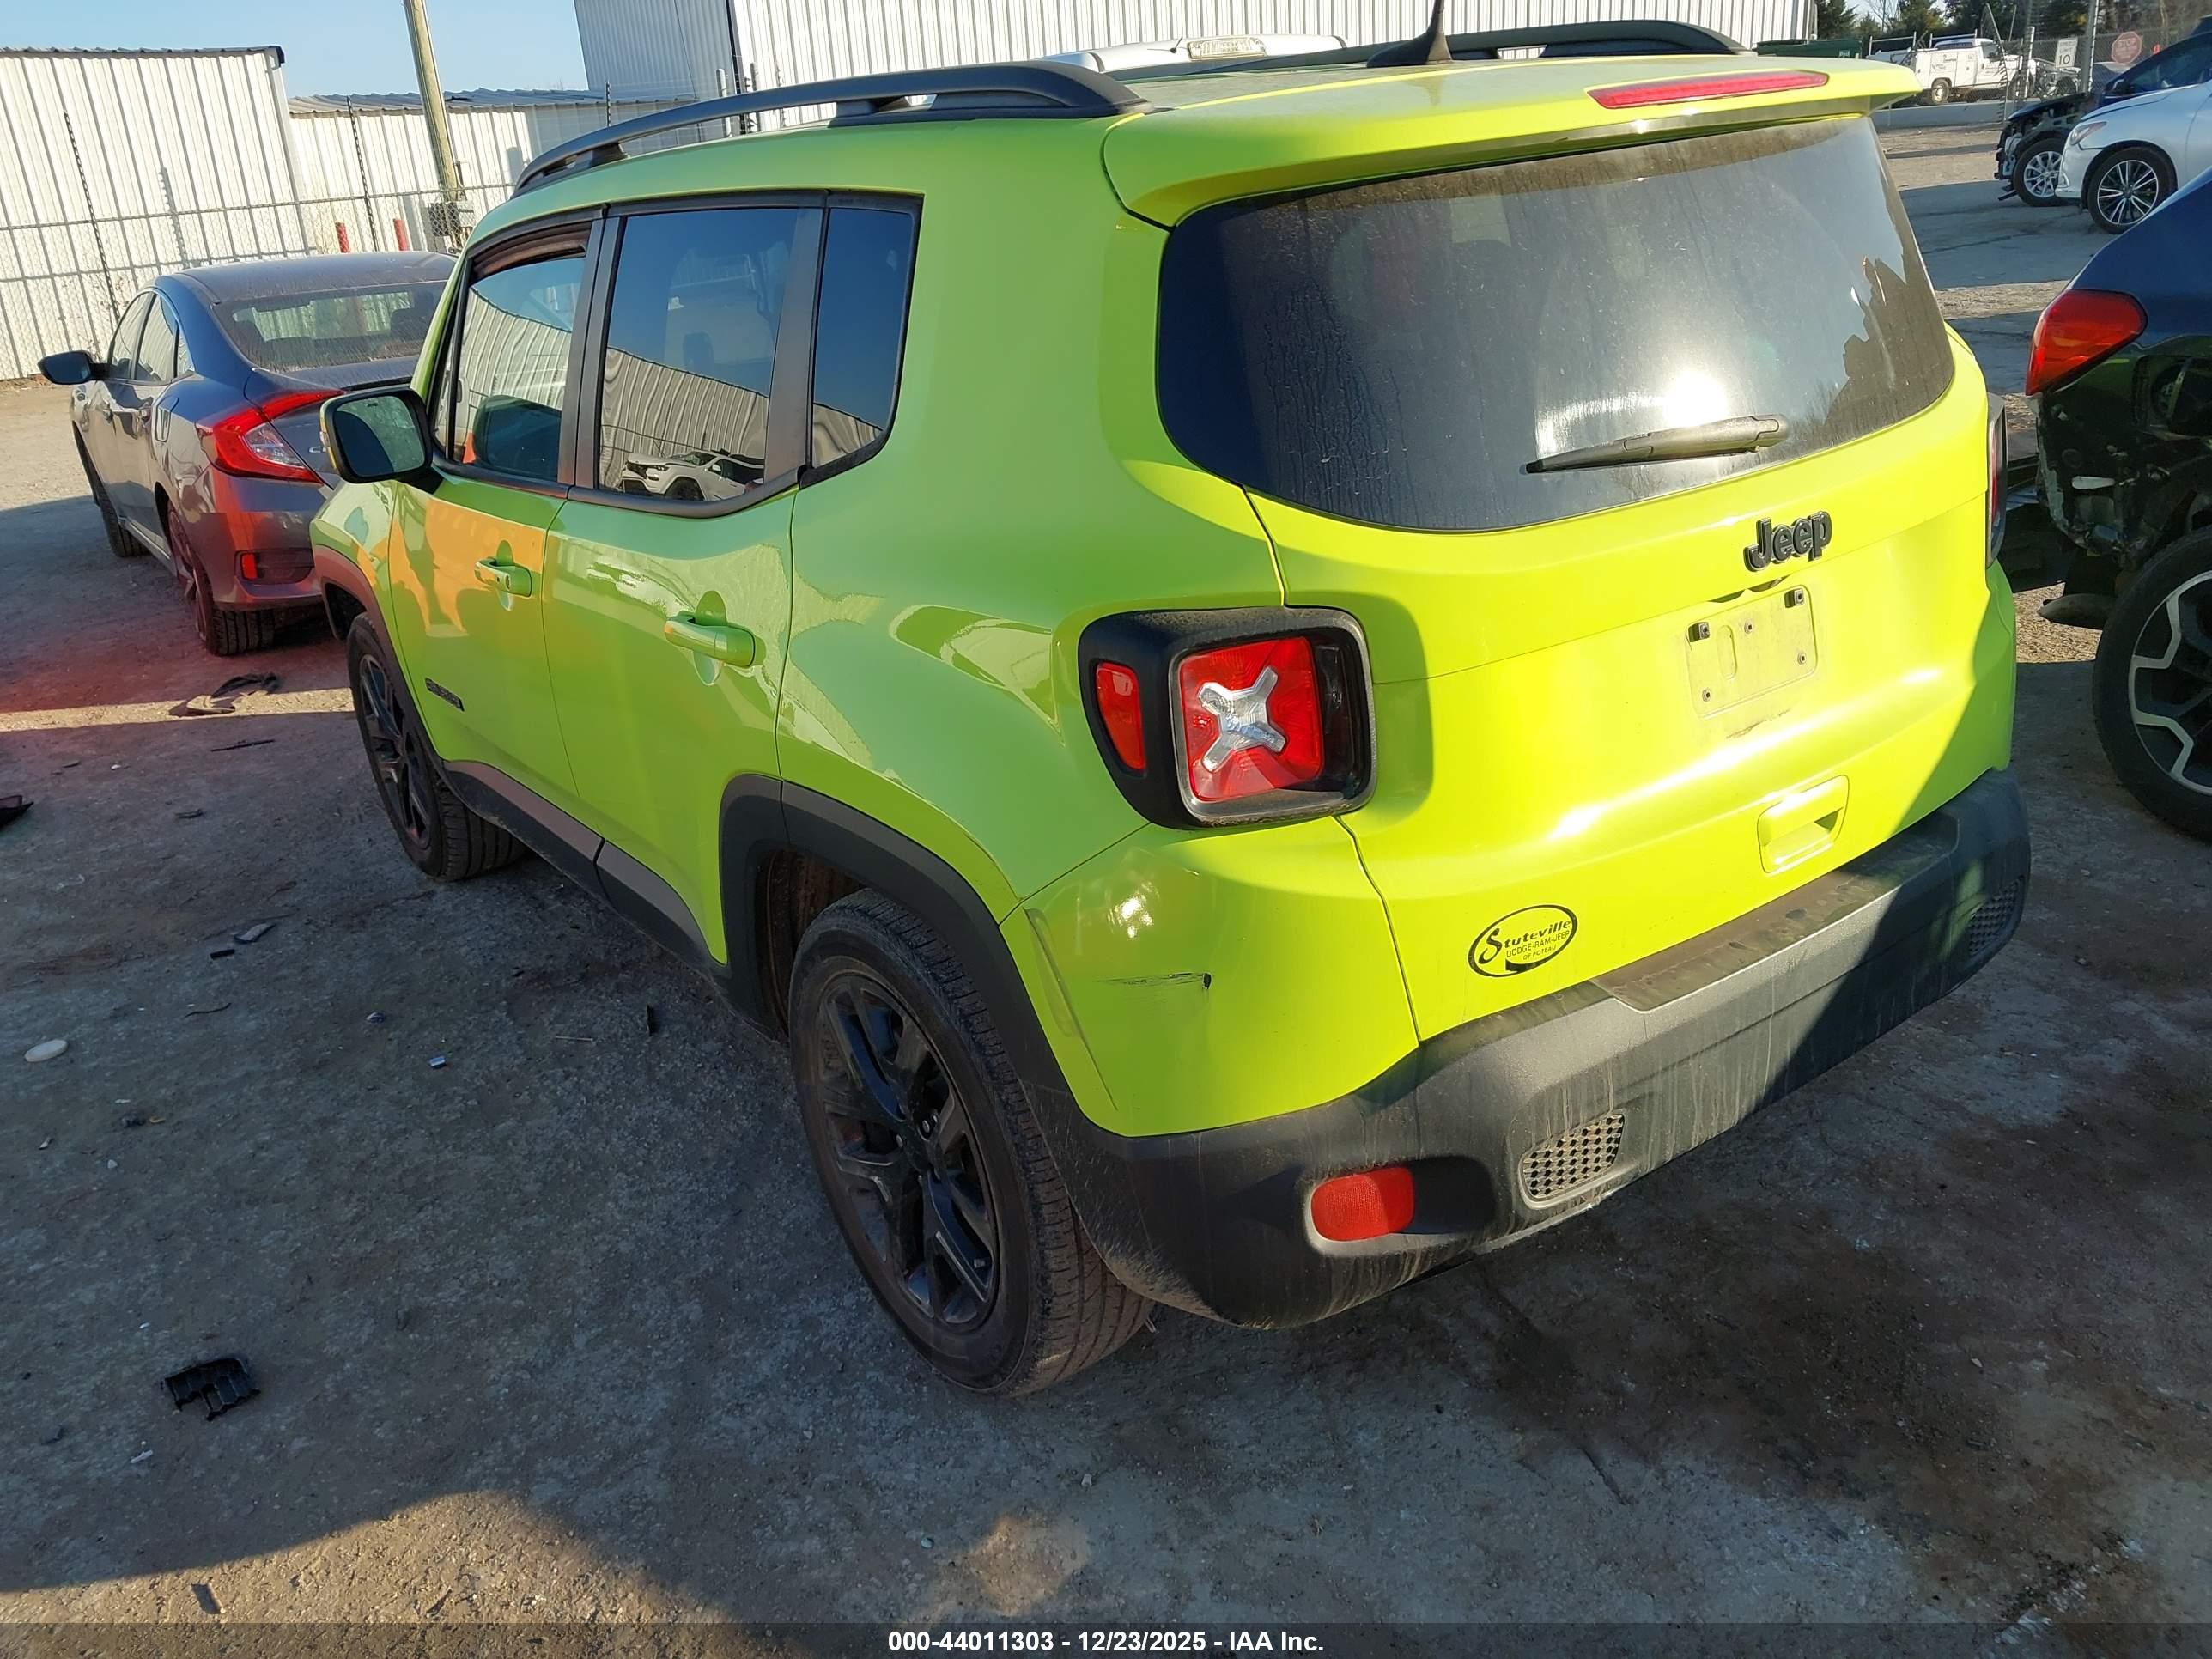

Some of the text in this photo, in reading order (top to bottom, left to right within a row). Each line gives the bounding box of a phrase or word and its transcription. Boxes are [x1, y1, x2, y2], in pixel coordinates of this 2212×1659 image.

[2059, 54, 2070, 65] 10
[1743, 511, 1832, 572] Jeep
[1479, 921, 1571, 964] Stuteville
